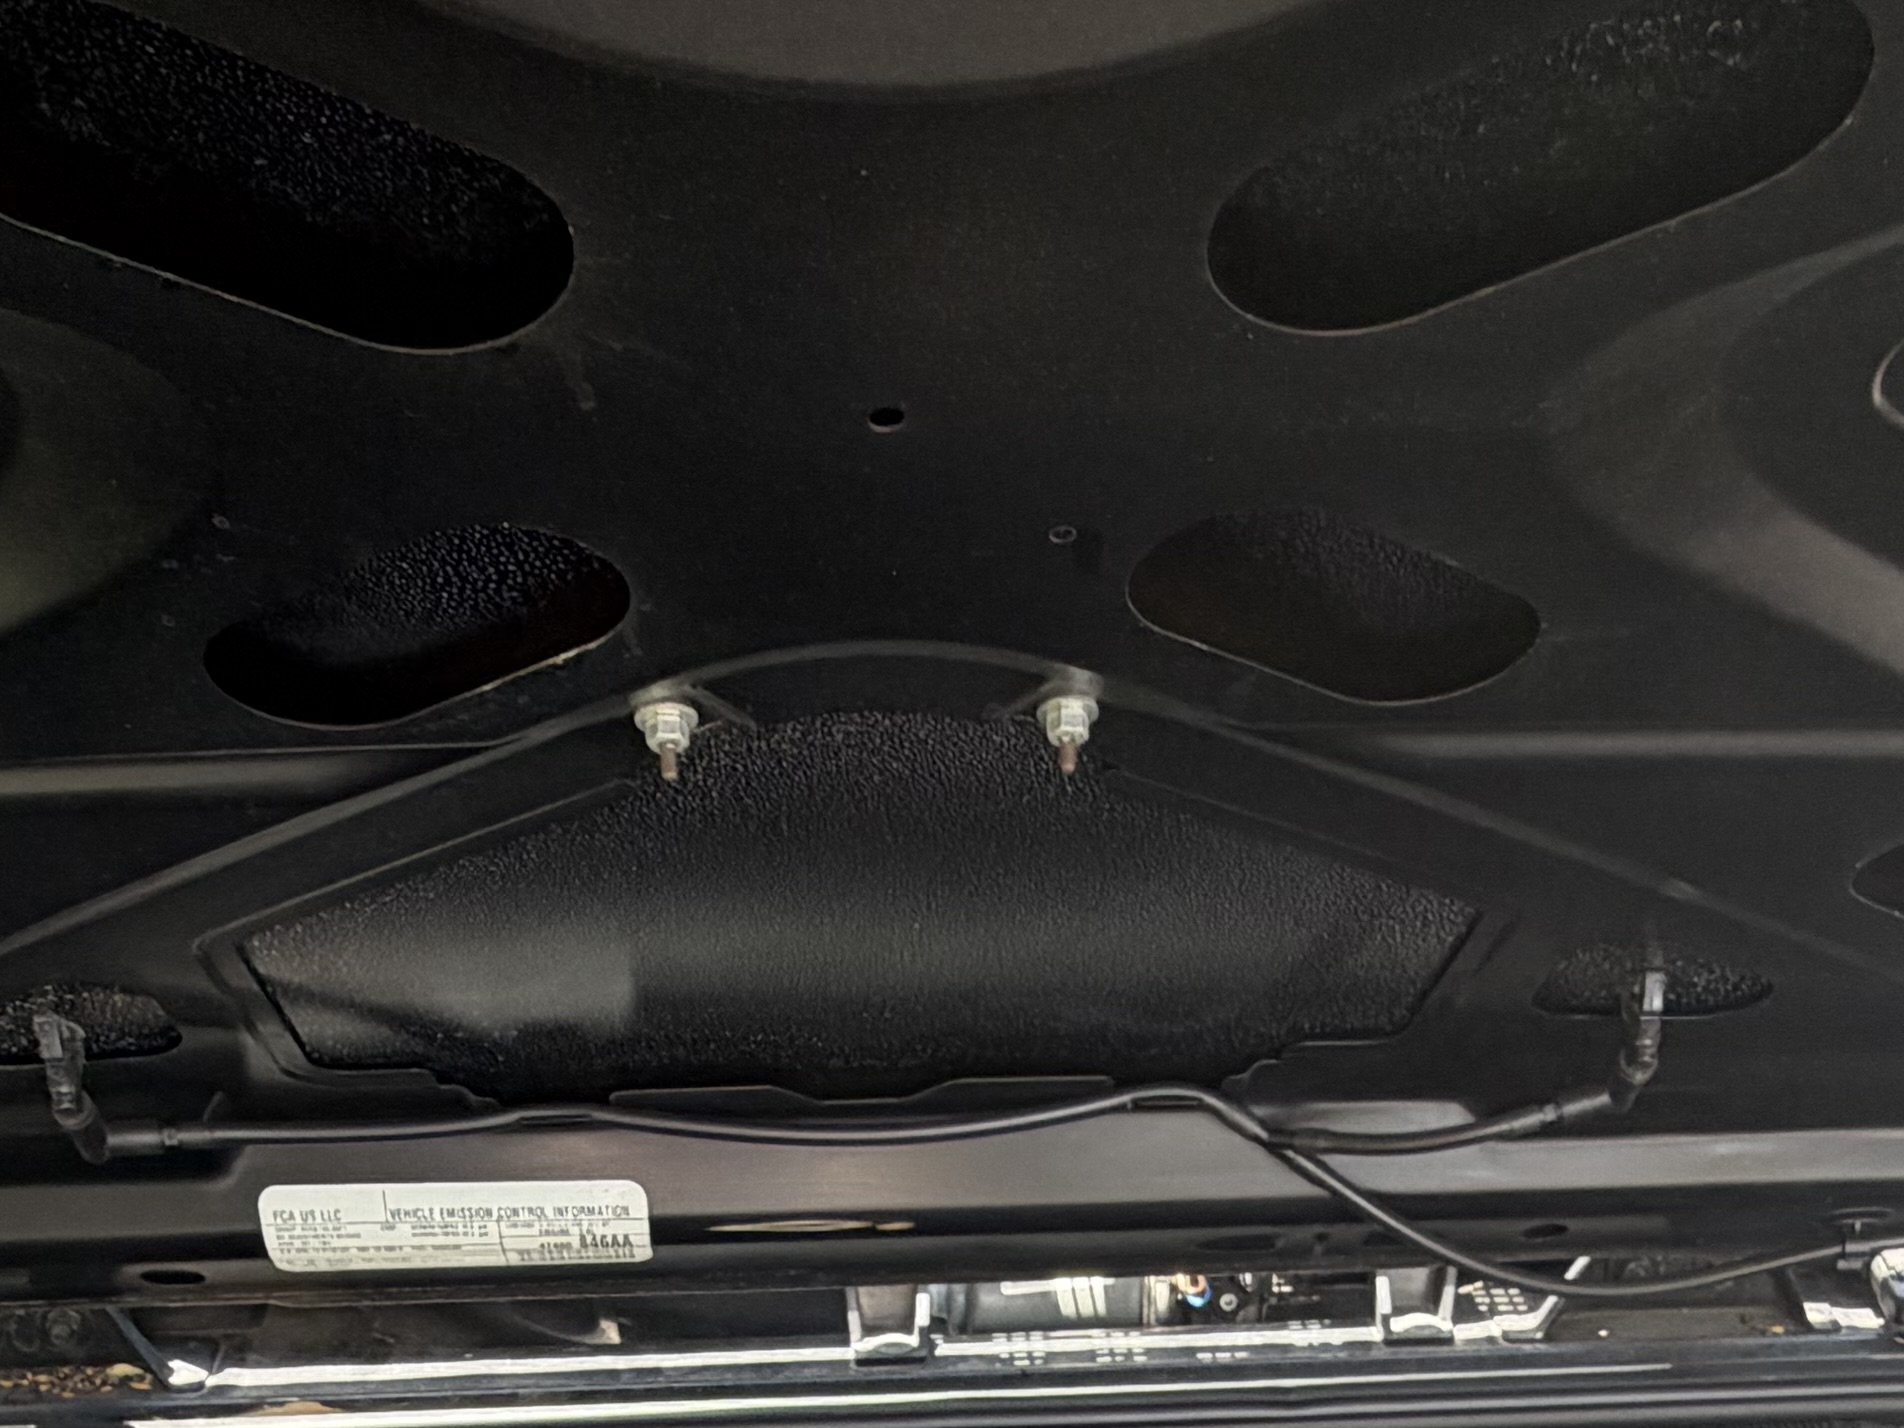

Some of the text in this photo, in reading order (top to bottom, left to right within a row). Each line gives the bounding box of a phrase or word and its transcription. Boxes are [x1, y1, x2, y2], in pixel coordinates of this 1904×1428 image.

[271, 1208, 342, 1223] FCA US LLC
[388, 1204, 631, 1222] VEHICLE EMISSION CONTROL INFORMATION
